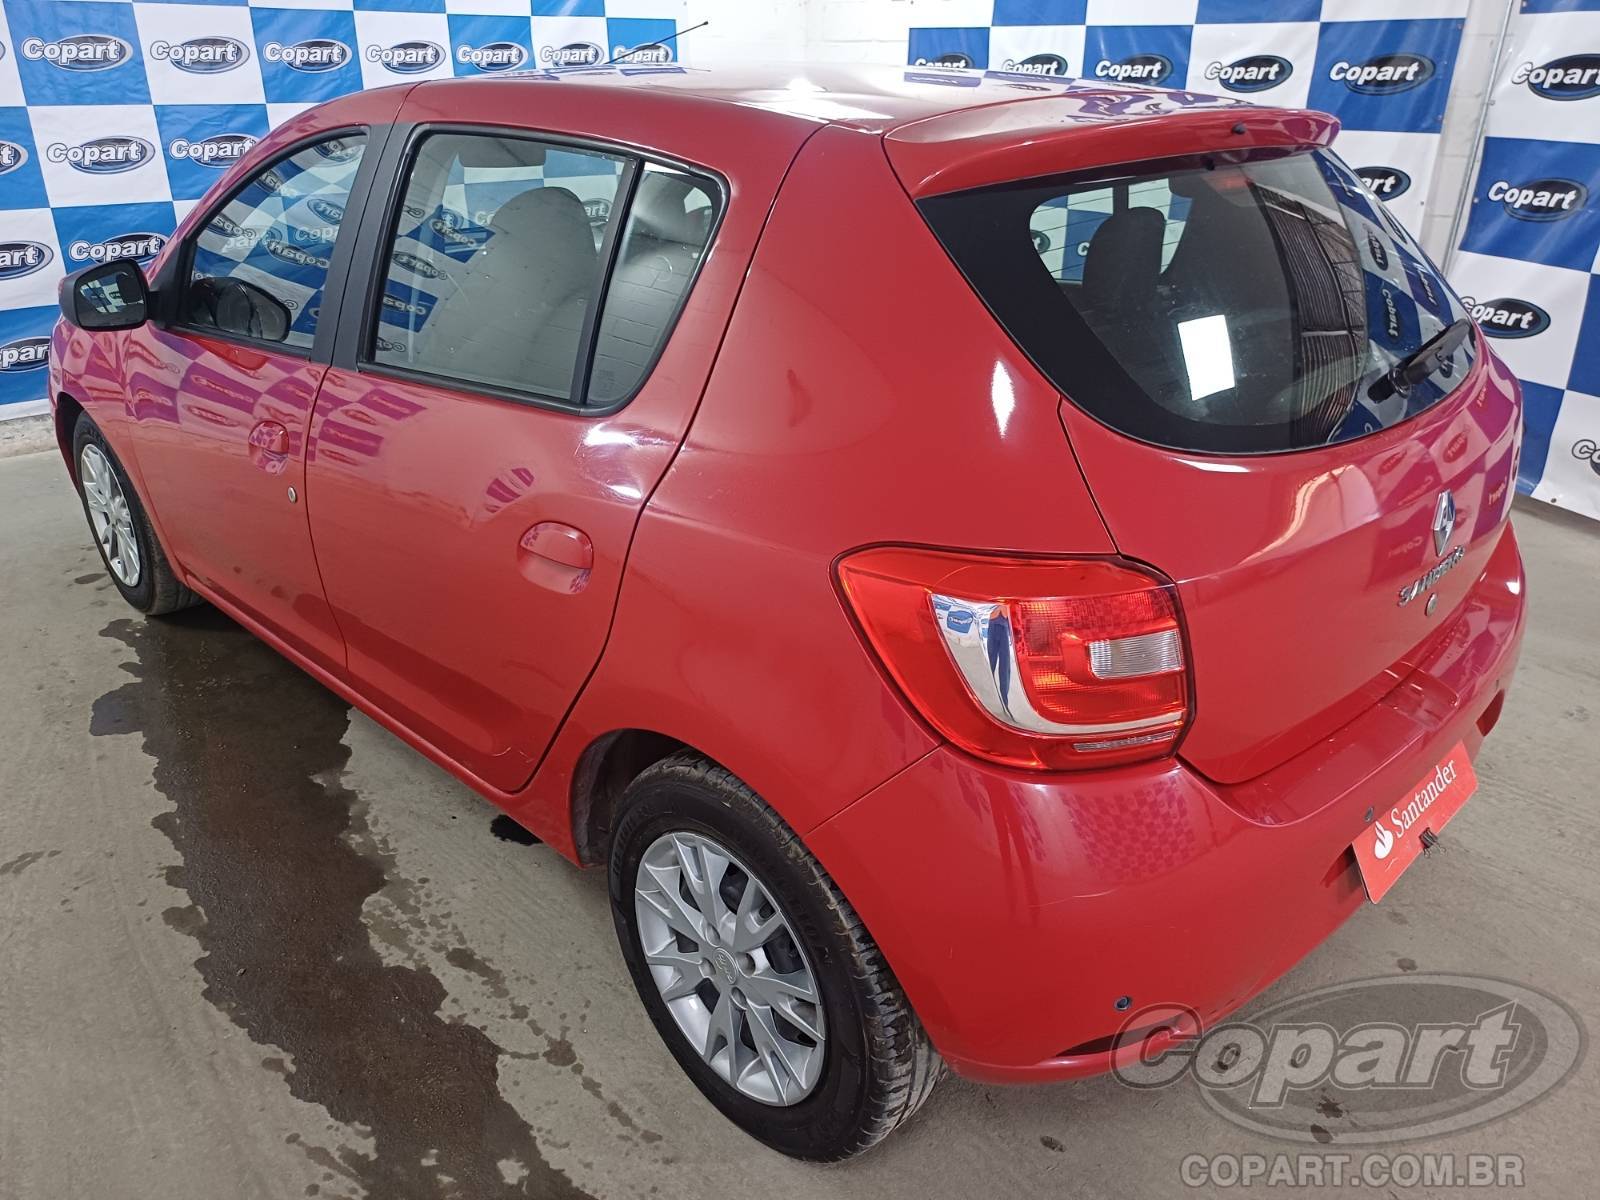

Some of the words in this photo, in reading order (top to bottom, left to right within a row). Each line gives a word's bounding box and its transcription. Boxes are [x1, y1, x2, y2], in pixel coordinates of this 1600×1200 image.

[22, 37, 120, 65] Copart
[150, 39, 238, 66] Copart
[263, 42, 343, 67] Copart
[366, 44, 436, 67] Copart
[456, 44, 521, 67] Copart
[540, 45, 595, 64] Copart
[1095, 60, 1162, 81] Copart
[1205, 61, 1281, 82] Copart
[1329, 60, 1420, 86] Copart
[47, 140, 141, 168] Copart
[1487, 180, 1578, 210] Copart
[69, 236, 161, 262] Copart
[1390, 759, 1457, 839] Santander
